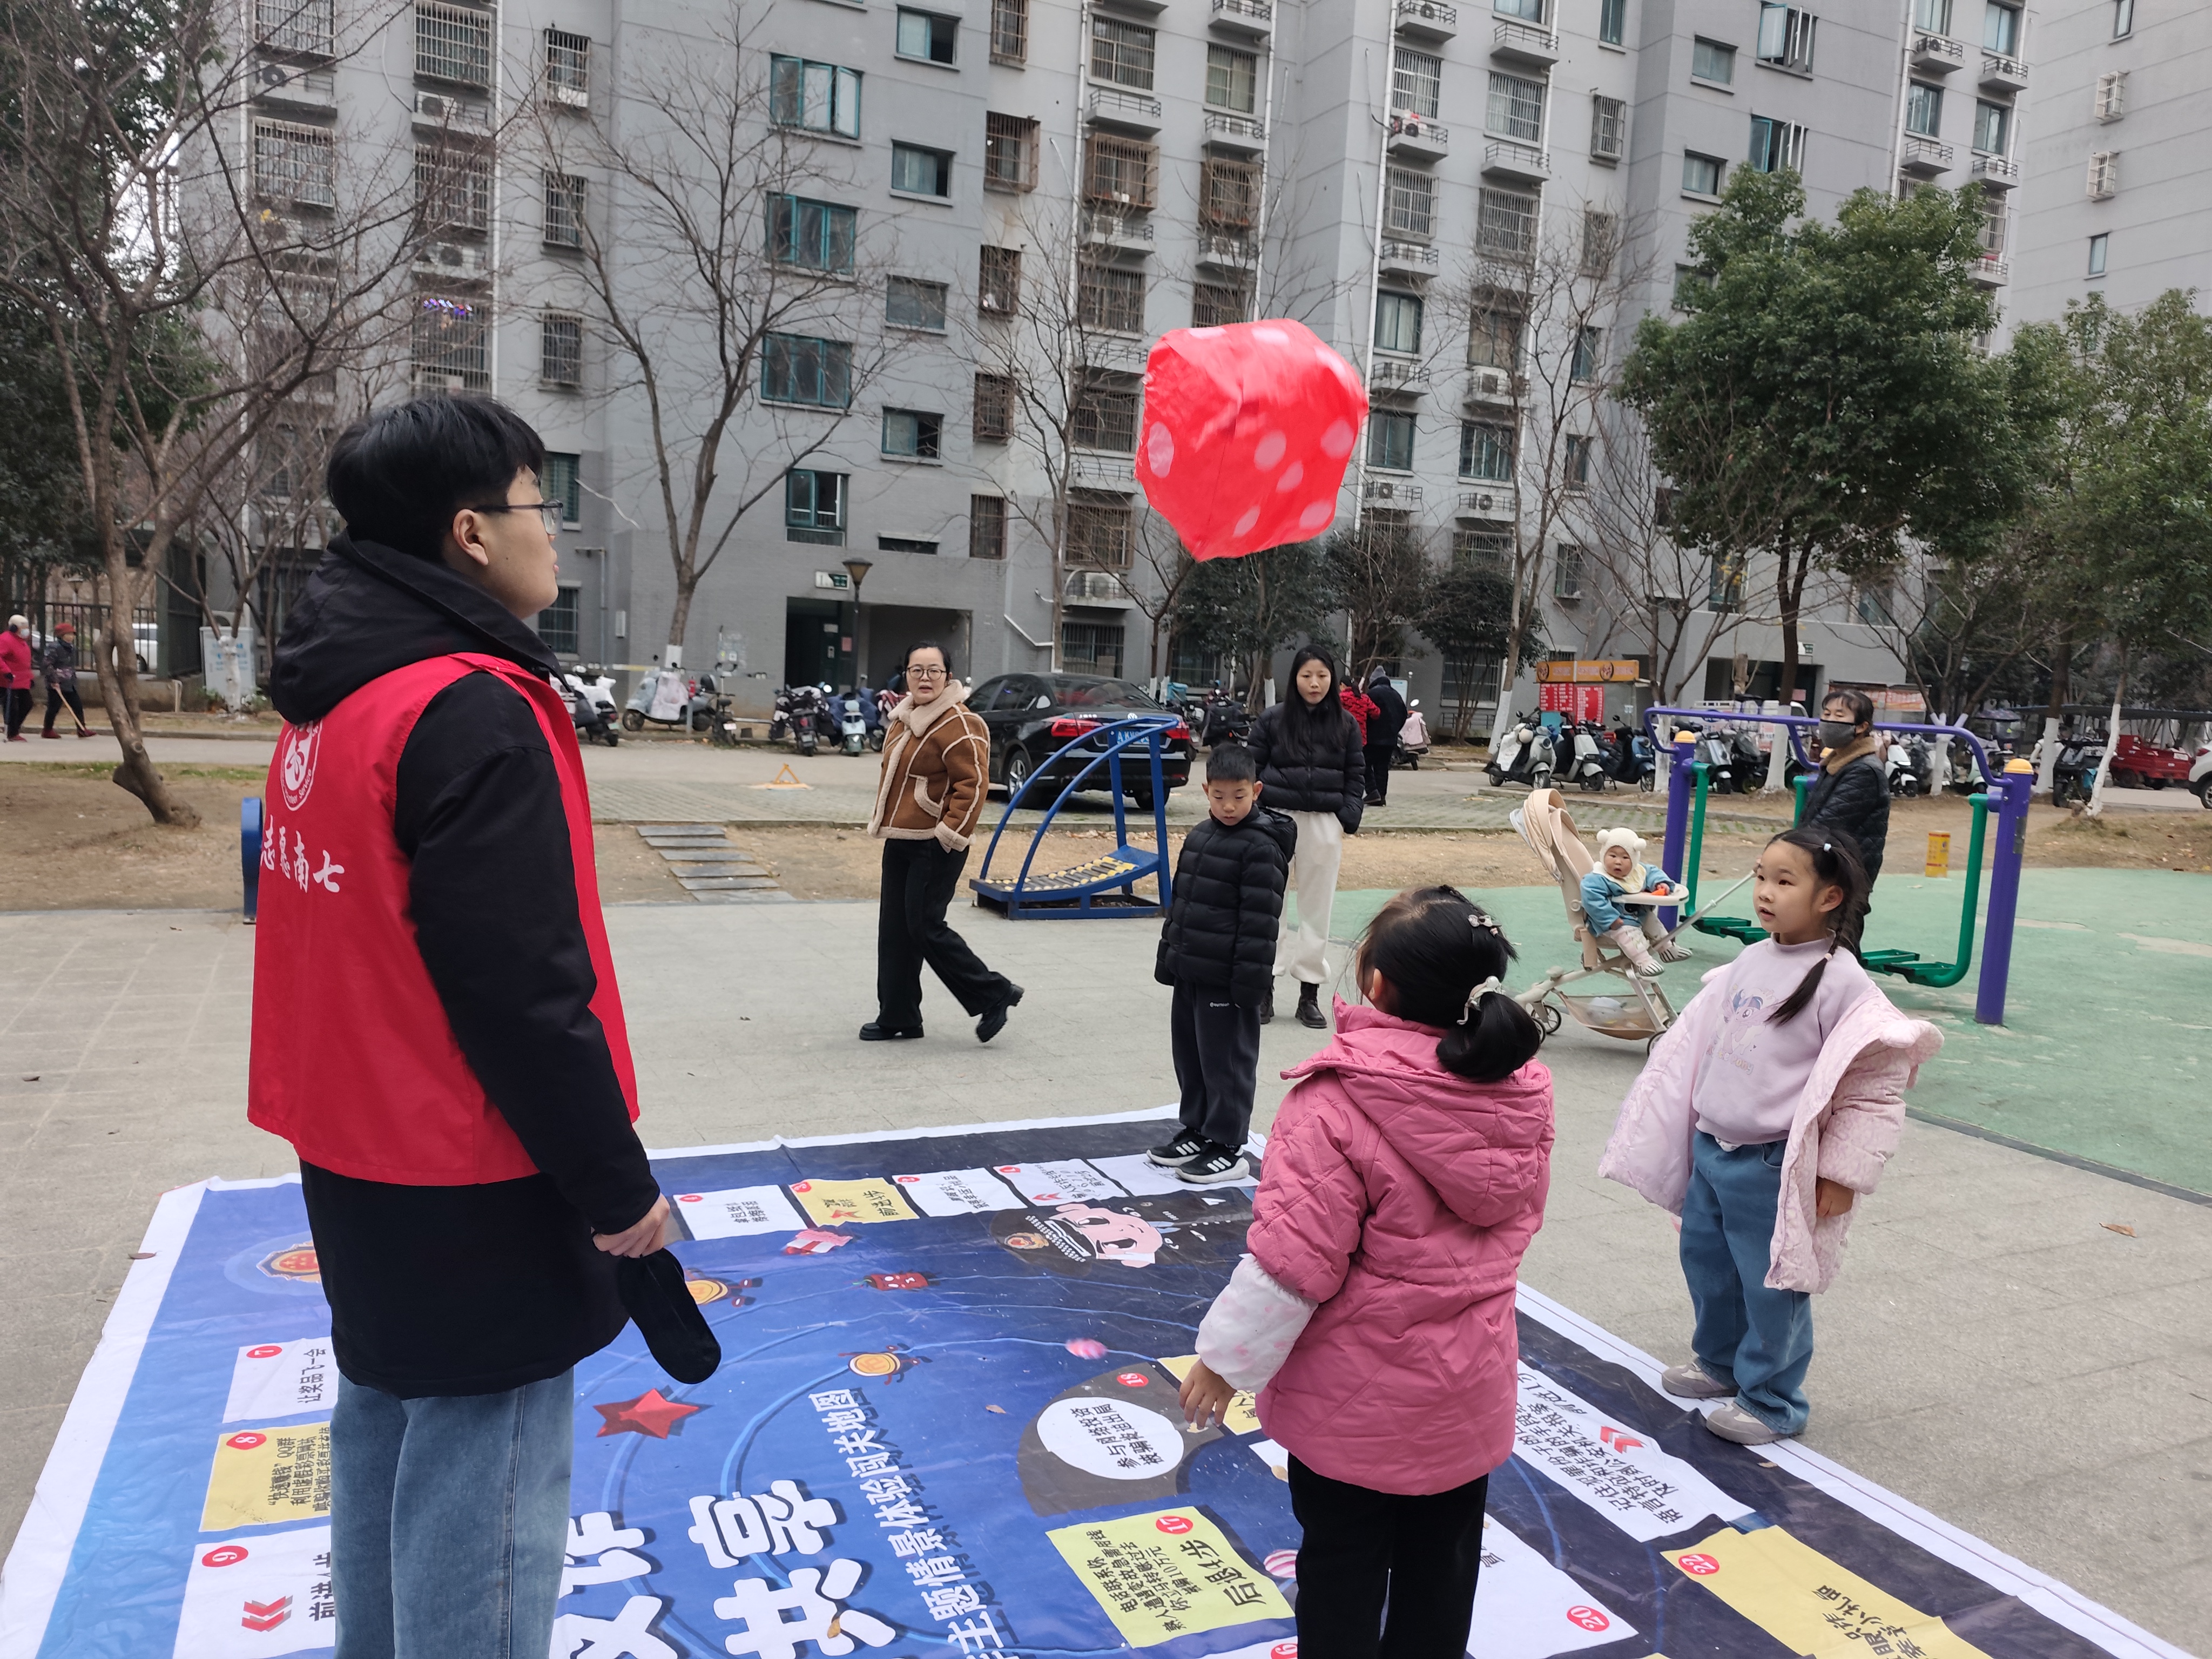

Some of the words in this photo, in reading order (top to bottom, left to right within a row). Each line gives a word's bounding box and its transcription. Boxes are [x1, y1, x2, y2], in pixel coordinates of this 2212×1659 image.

[298, 1348, 327, 1404] 让奖品飞一会
[1120, 1372, 1144, 1386] 18
[235, 1437, 258, 1445] 8
[1069, 1407, 1142, 1469] 参与网络投资
[1527, 1402, 1680, 1499] 及时到公安机关报案
[1158, 1518, 1189, 1532] 17
[212, 1551, 238, 1562] 9
[1085, 1529, 1187, 1633] 熟人遭遇变故急需用钱
[1119, 1541, 1192, 1611] 你立马转账过去
[1179, 1539, 1267, 1607] 后退4步
[1681, 1554, 1717, 1574] 22
[1087, 1556, 1138, 1613] 电话联系你
[1570, 1607, 1606, 1629] 20
[1820, 1612, 1896, 1659] 眼识诈
